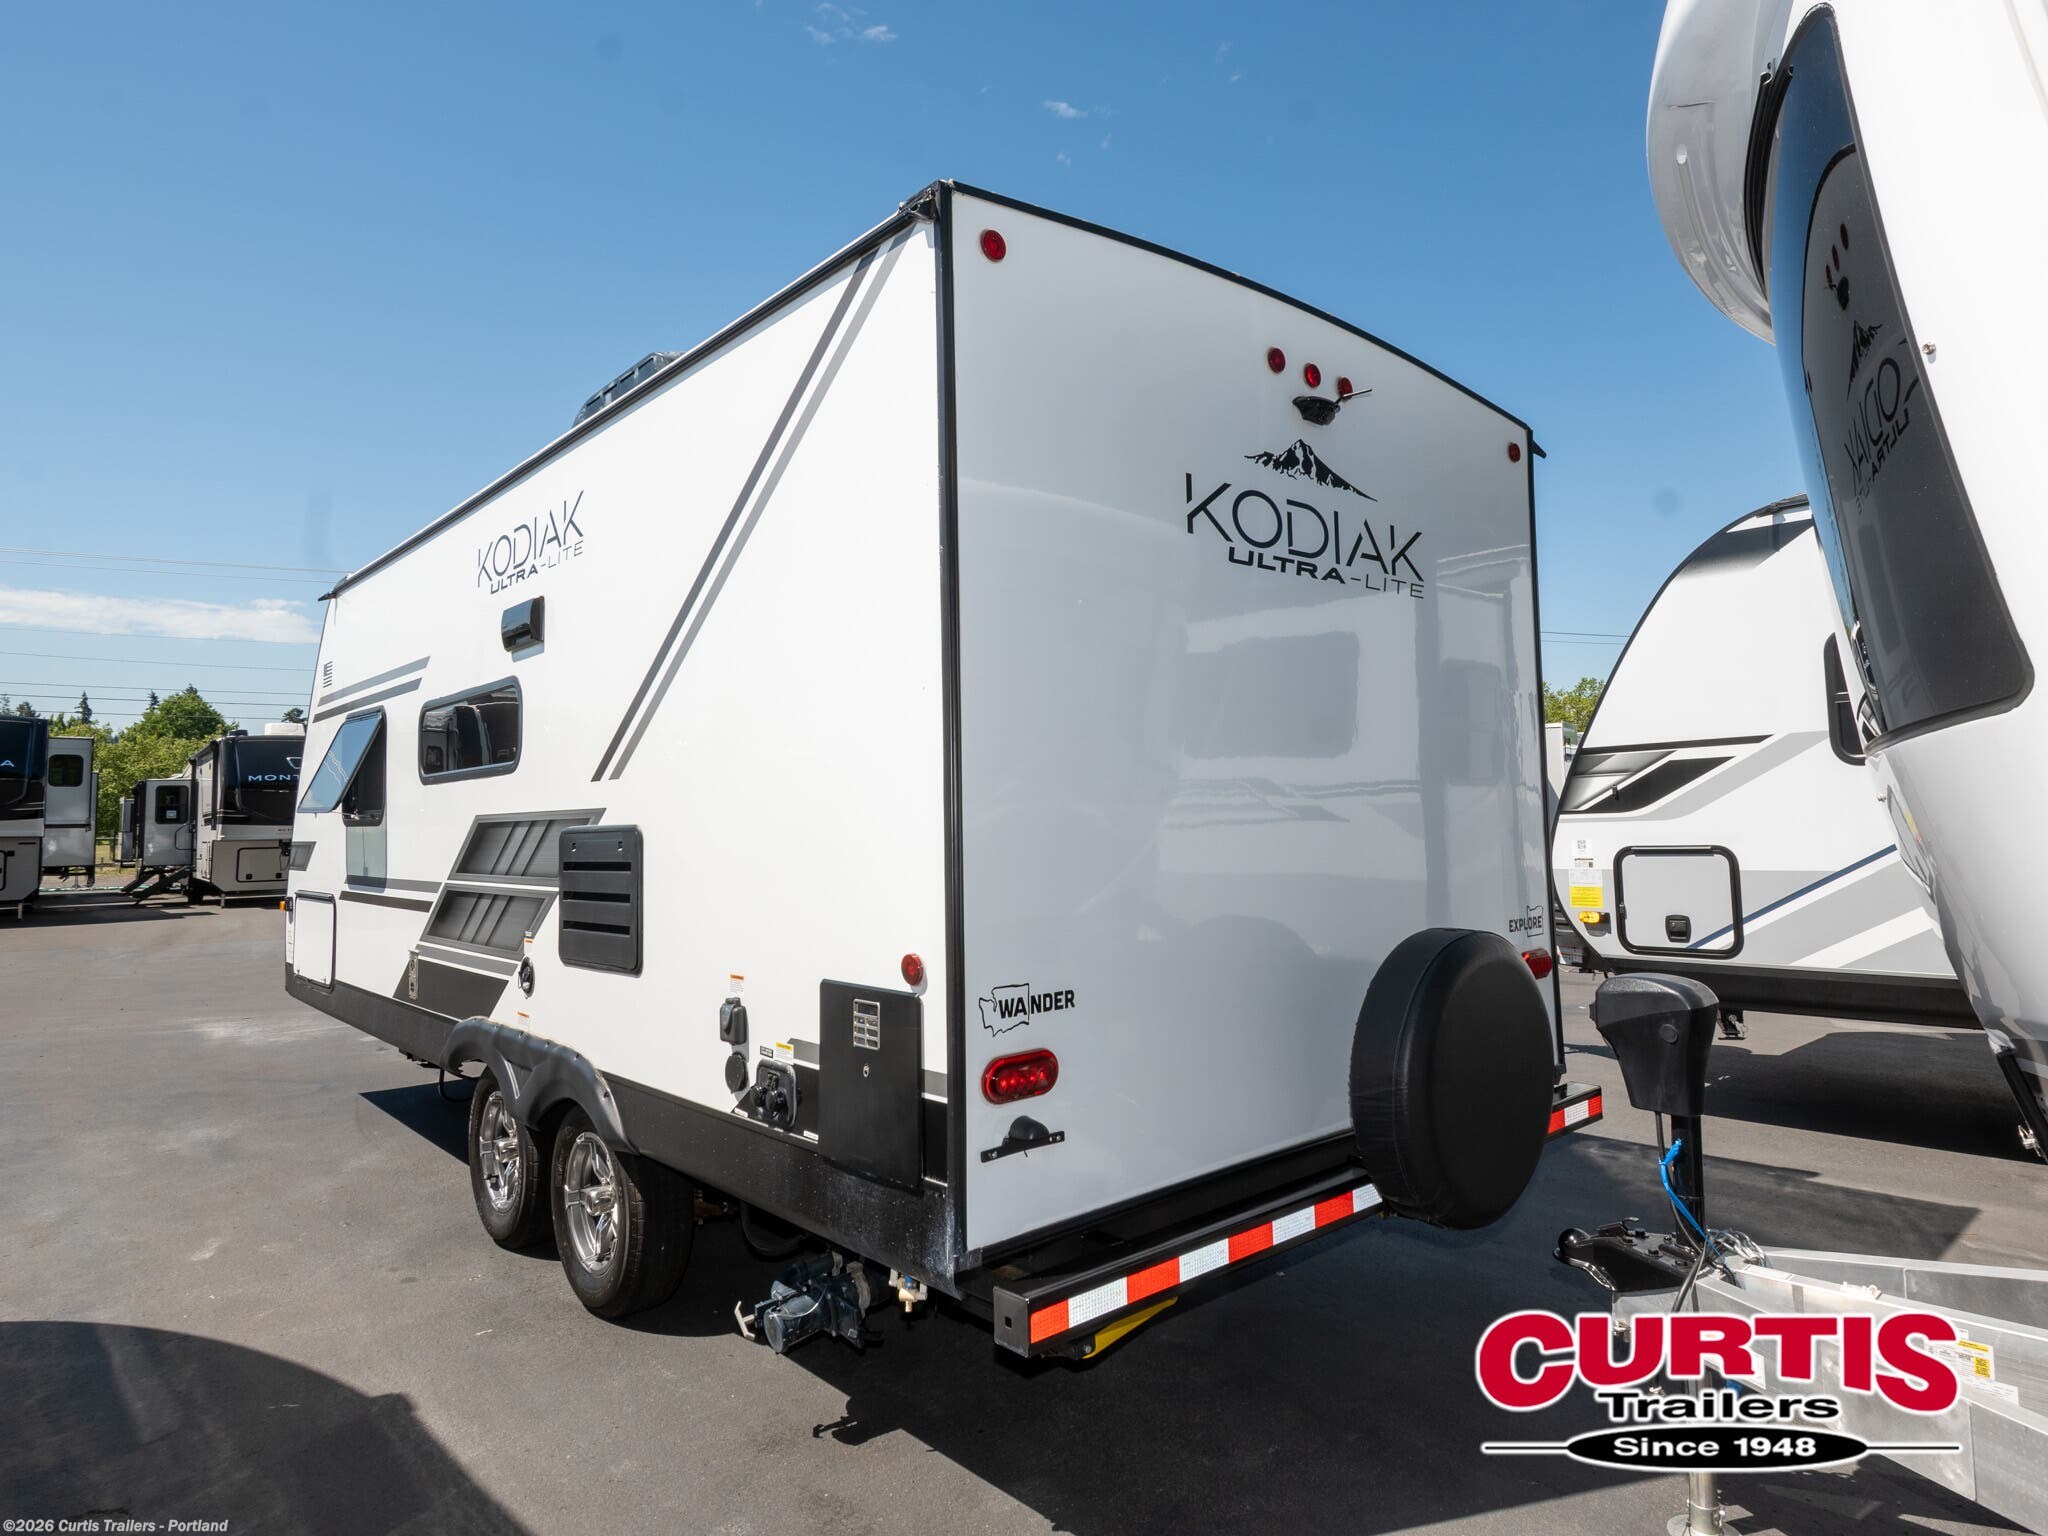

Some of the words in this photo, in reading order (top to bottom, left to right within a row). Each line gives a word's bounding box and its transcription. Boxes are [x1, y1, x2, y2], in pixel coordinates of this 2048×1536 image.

[477, 490, 584, 588] KODIAK
[1186, 473, 1425, 582] KODIAK
[490, 540, 584, 595] ULTRA-LITE
[1228, 546, 1425, 600] ULTRA-LITE
[1508, 916, 1543, 933] EXPLORE
[998, 989, 1075, 1019] WANDER
